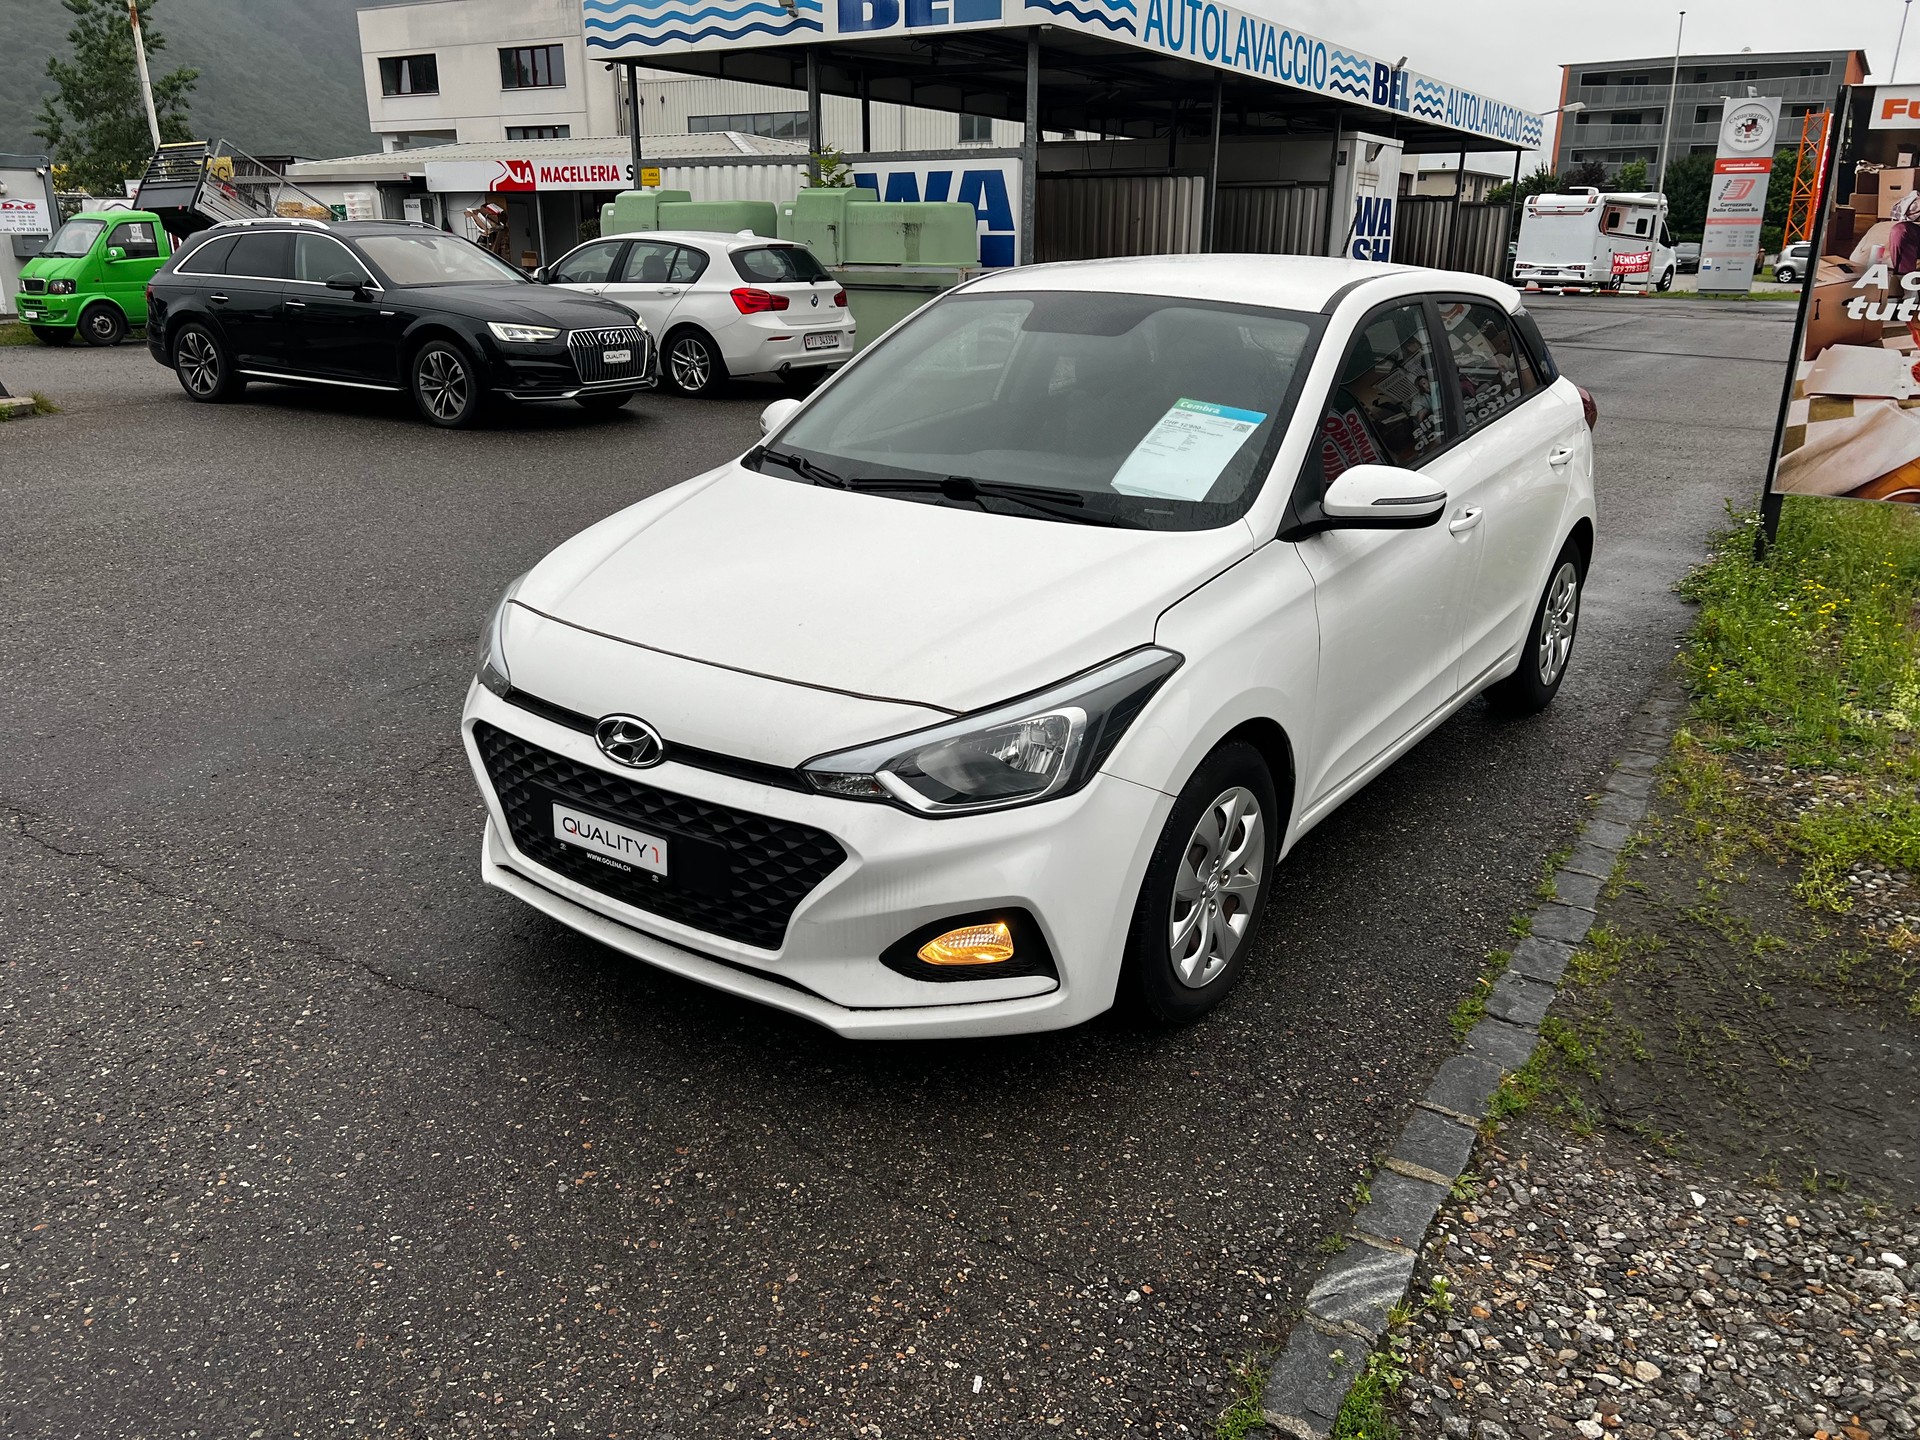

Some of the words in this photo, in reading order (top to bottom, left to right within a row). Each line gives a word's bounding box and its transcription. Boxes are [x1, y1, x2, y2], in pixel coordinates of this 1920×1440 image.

[1144, 0, 1327, 90] AUTOLAVACCIO
[1372, 62, 1410, 112] BEL
[1445, 88, 1523, 142] AUTOLAVACCIO
[540, 165, 621, 183] MACELLERIA
[1853, 264, 1889, 289] A
[1180, 401, 1220, 415] Cembra
[562, 816, 647, 858] QUALITY
[651, 846, 659, 864] 1
[586, 852, 632, 873] WWW.GOLENA.CH
